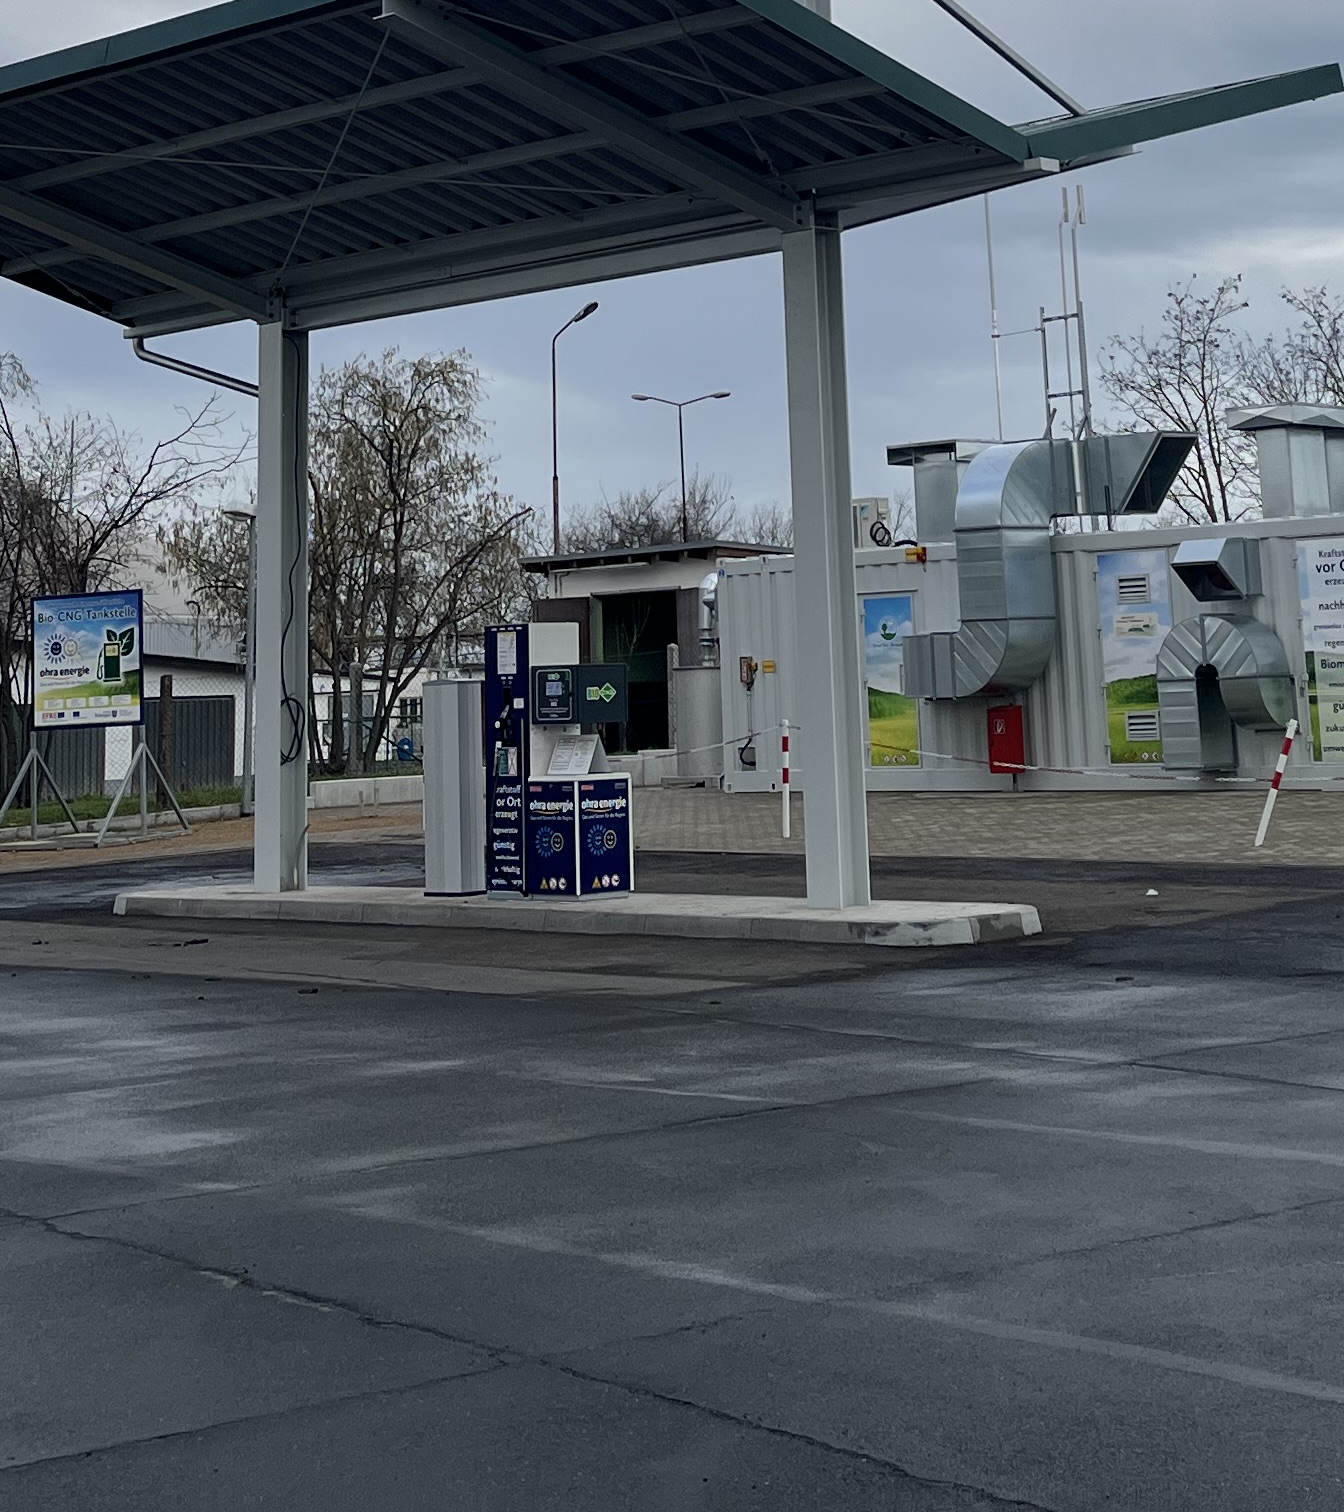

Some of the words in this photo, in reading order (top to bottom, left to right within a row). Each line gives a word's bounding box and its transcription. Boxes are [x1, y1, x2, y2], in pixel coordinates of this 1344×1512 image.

[1315, 562, 1335, 573] vor
[86, 606, 136, 619] Tankstelle
[40, 668, 58, 677] ohra
[60, 666, 89, 677] energie
[506, 796, 522, 807] Ort
[581, 798, 598, 809] ohra
